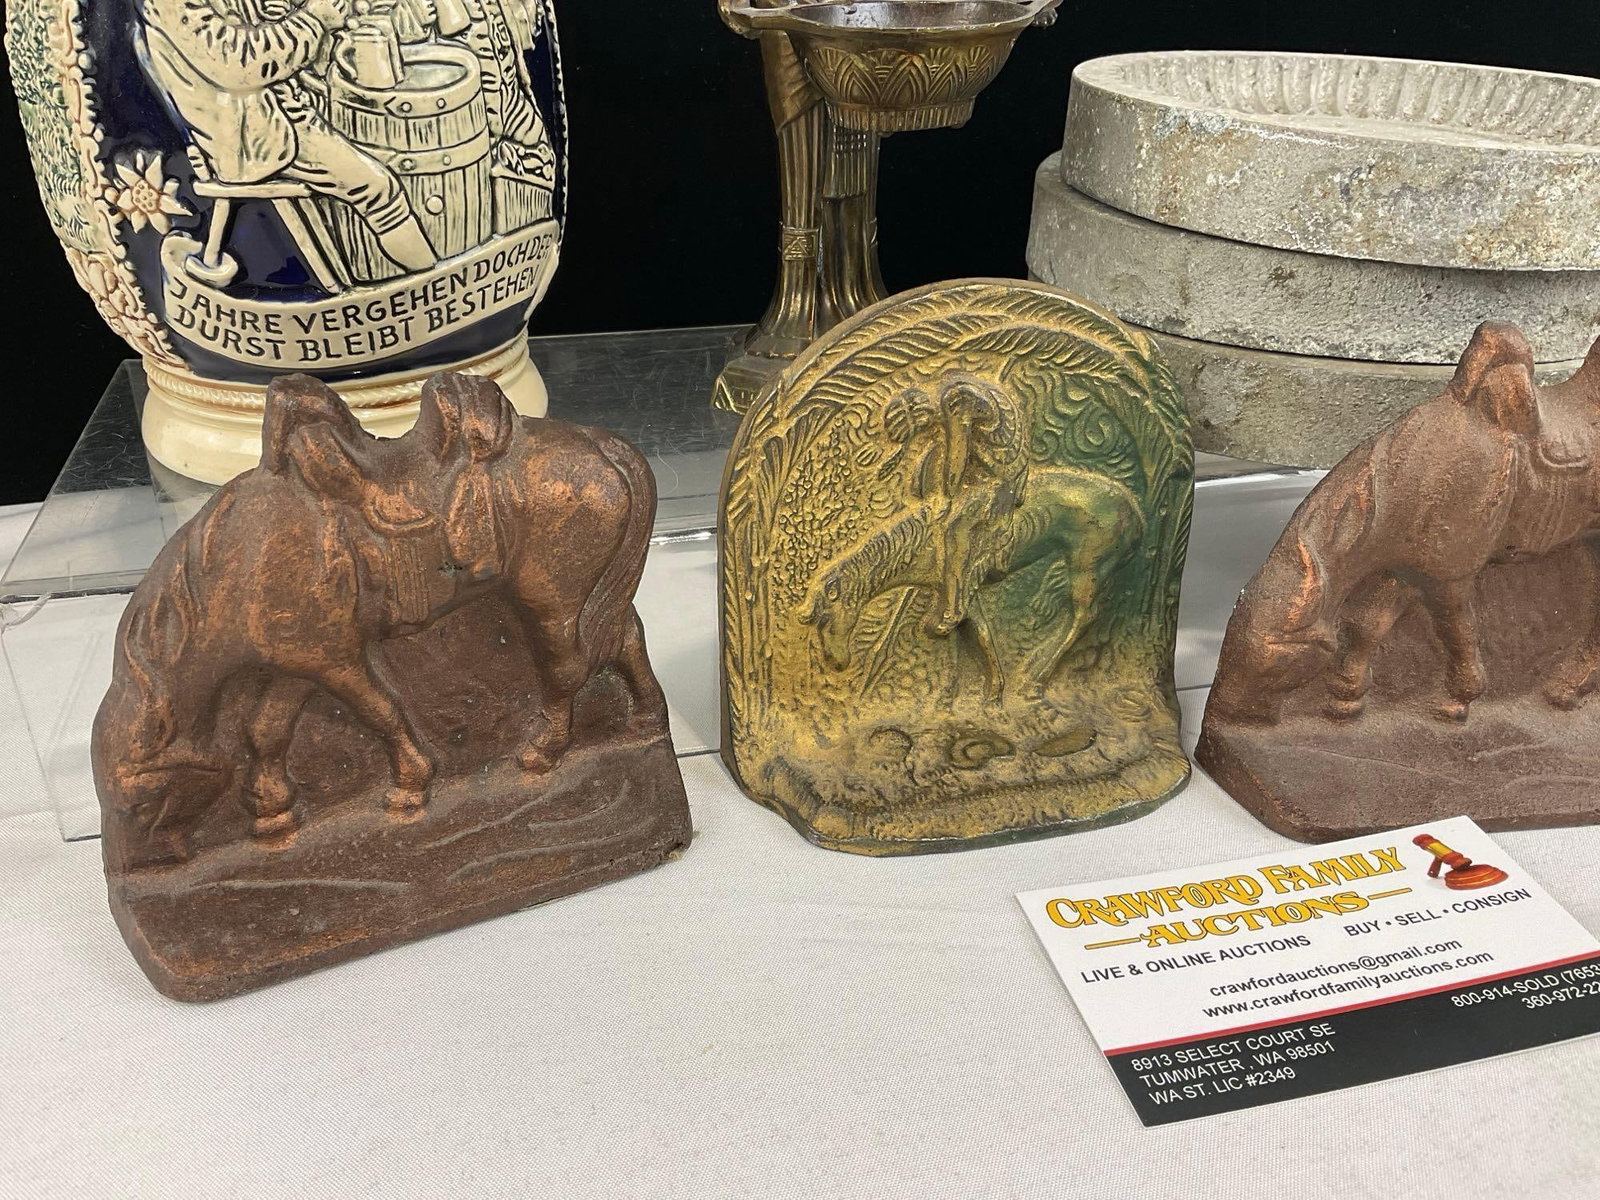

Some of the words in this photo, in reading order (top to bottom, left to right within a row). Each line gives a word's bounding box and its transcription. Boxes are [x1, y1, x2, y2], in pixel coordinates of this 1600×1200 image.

[170, 276, 284, 335] JAHRE
[292, 267, 468, 334] VERGEHEN
[473, 239, 530, 283] DOCH
[174, 304, 286, 360] DURST
[296, 315, 416, 362] BLEIBT
[424, 264, 540, 333] BESTEHEN
[1045, 874, 1264, 929] CRAWFORD
[1257, 846, 1407, 895] FAMILY
[1343, 919, 1381, 938] BUY
[1397, 908, 1443, 928] SELL
[1451, 887, 1533, 915] CONSIGN
[1140, 891, 1371, 948] AUCTIONS
[1080, 967, 1126, 984] LIVE
[1127, 963, 1144, 976] &
[1145, 950, 1217, 975] ONLINE
[1219, 934, 1312, 961] AUCTIONS
[1202, 951, 1494, 1019] www.crawfordfamilyauctions.com
[1209, 936, 1463, 998] crawfordauctions@gmail.com
[1450, 974, 1560, 1008] 800-914-SOLD
[1131, 1053, 1174, 1073] 8913
[1174, 1040, 1242, 1064] SELECT
[1245, 1028, 1306, 1051] COURT
[1308, 1022, 1336, 1038] SE
[1252, 1051, 1287, 1068] WA
[1289, 1040, 1337, 1061] 98501
[1149, 1088, 1184, 1106] WA
[1184, 1081, 1213, 1099] ST.
[1212, 1076, 1244, 1094] LIC
[1244, 1066, 1297, 1088] #2349
